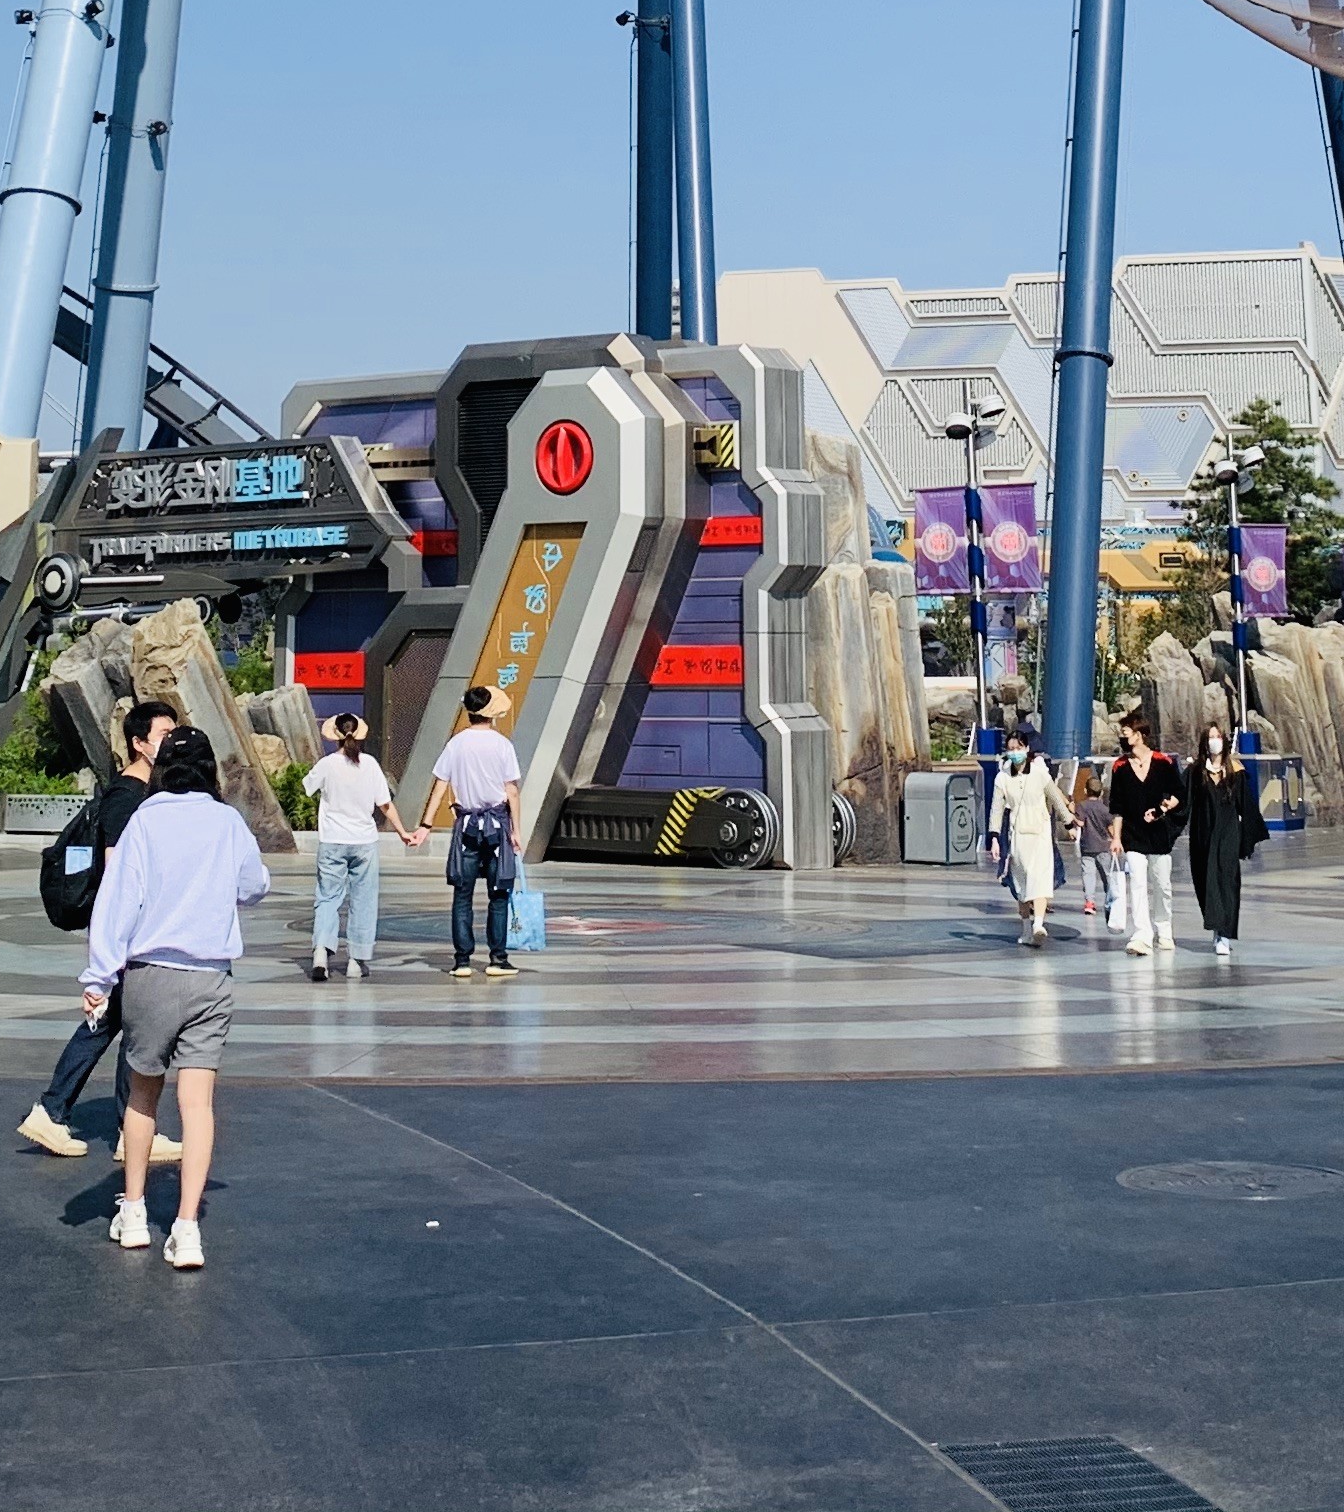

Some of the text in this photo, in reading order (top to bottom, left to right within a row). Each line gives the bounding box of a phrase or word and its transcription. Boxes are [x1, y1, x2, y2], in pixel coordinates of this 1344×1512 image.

[106, 454, 308, 513] 变形金刚基地
[233, 525, 349, 550] METROBASE
